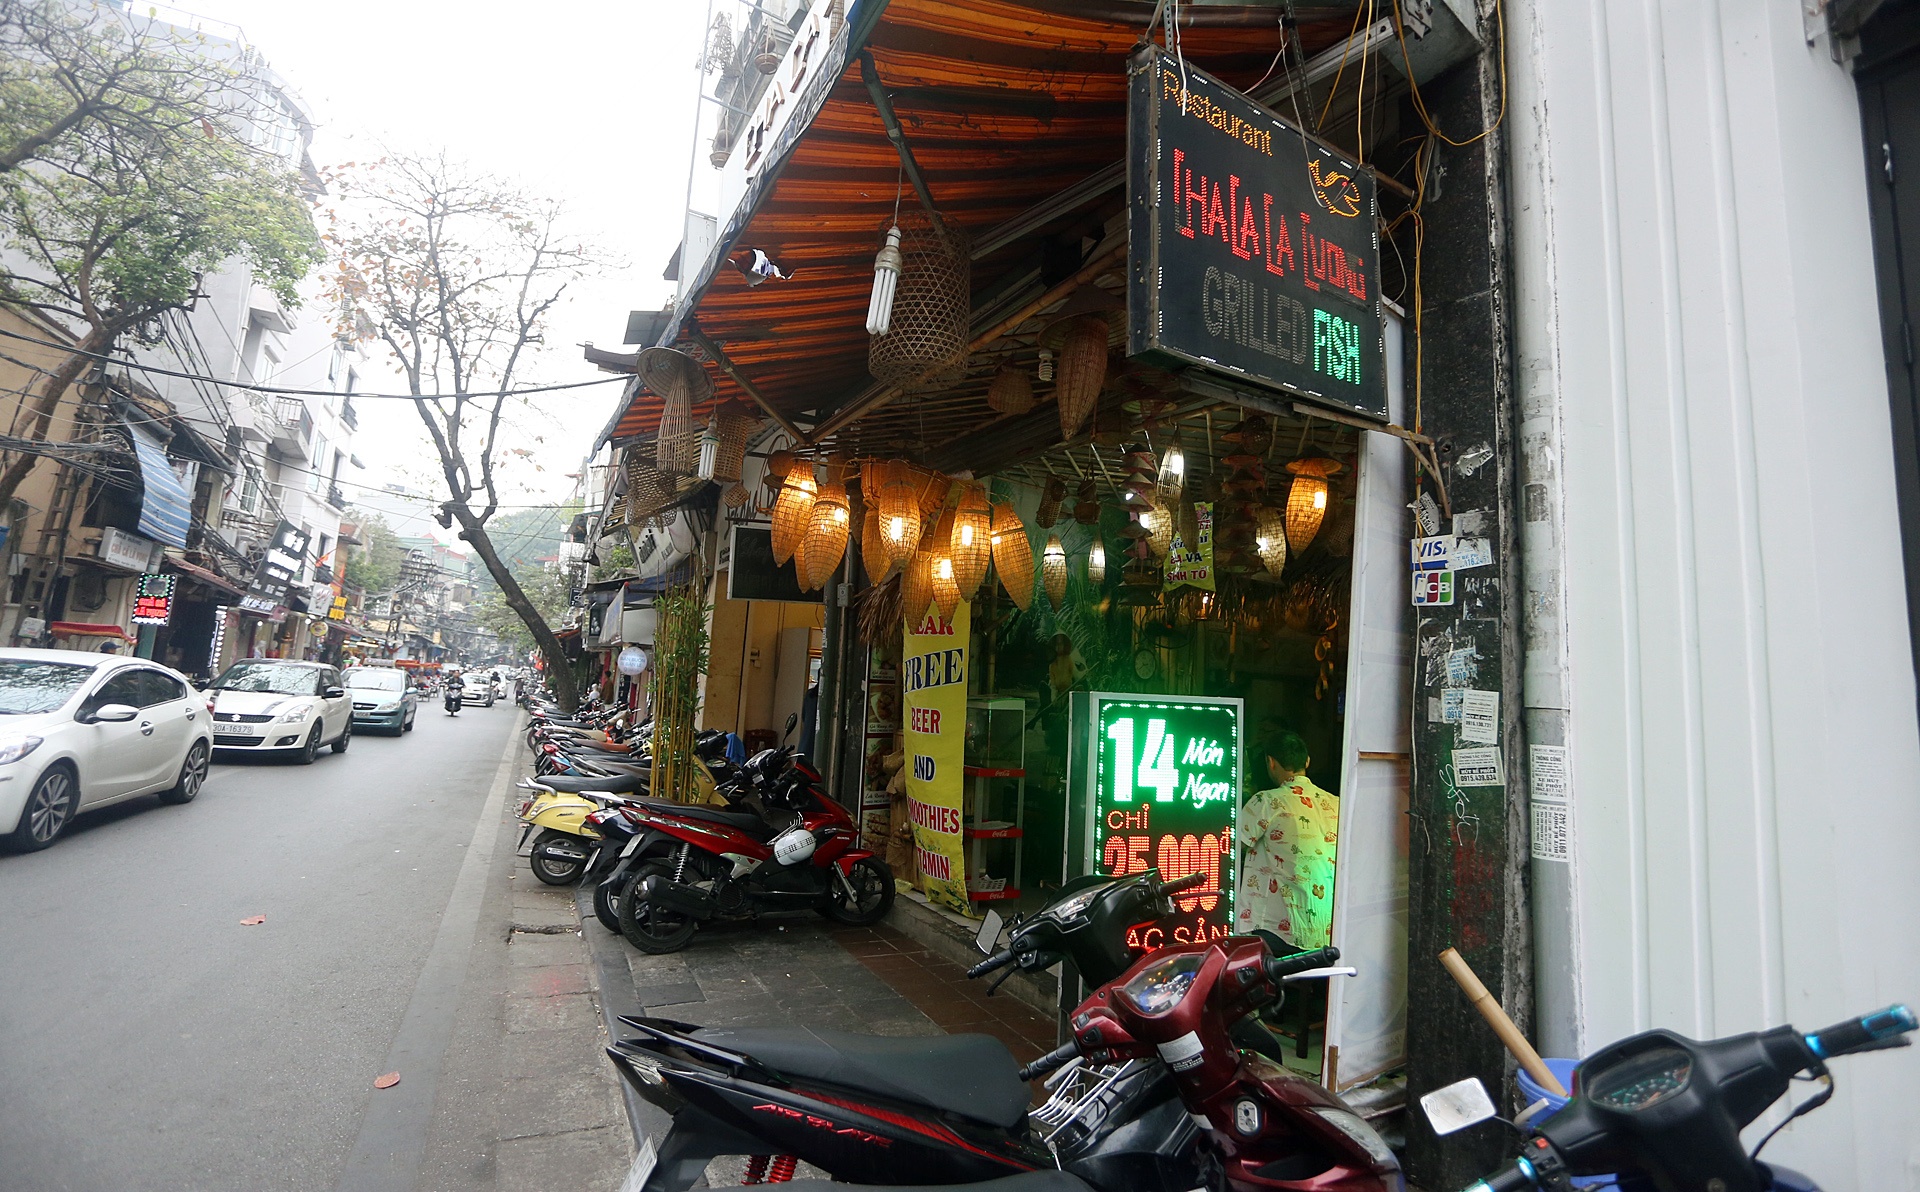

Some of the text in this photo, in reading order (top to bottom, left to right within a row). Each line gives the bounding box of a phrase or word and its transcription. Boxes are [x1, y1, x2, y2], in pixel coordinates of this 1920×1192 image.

[1163, 69, 1273, 157] Restaurant
[1203, 265, 1361, 386] GRILLED FISH
[1426, 582, 1451, 594] CB
[904, 648, 963, 693] FREE
[911, 706, 941, 734] BEER
[913, 754, 936, 781] AND
[1107, 717, 1225, 802] 14 Món
[1181, 772, 1229, 809] Ngon
[1107, 803, 1150, 830] CHỈ
